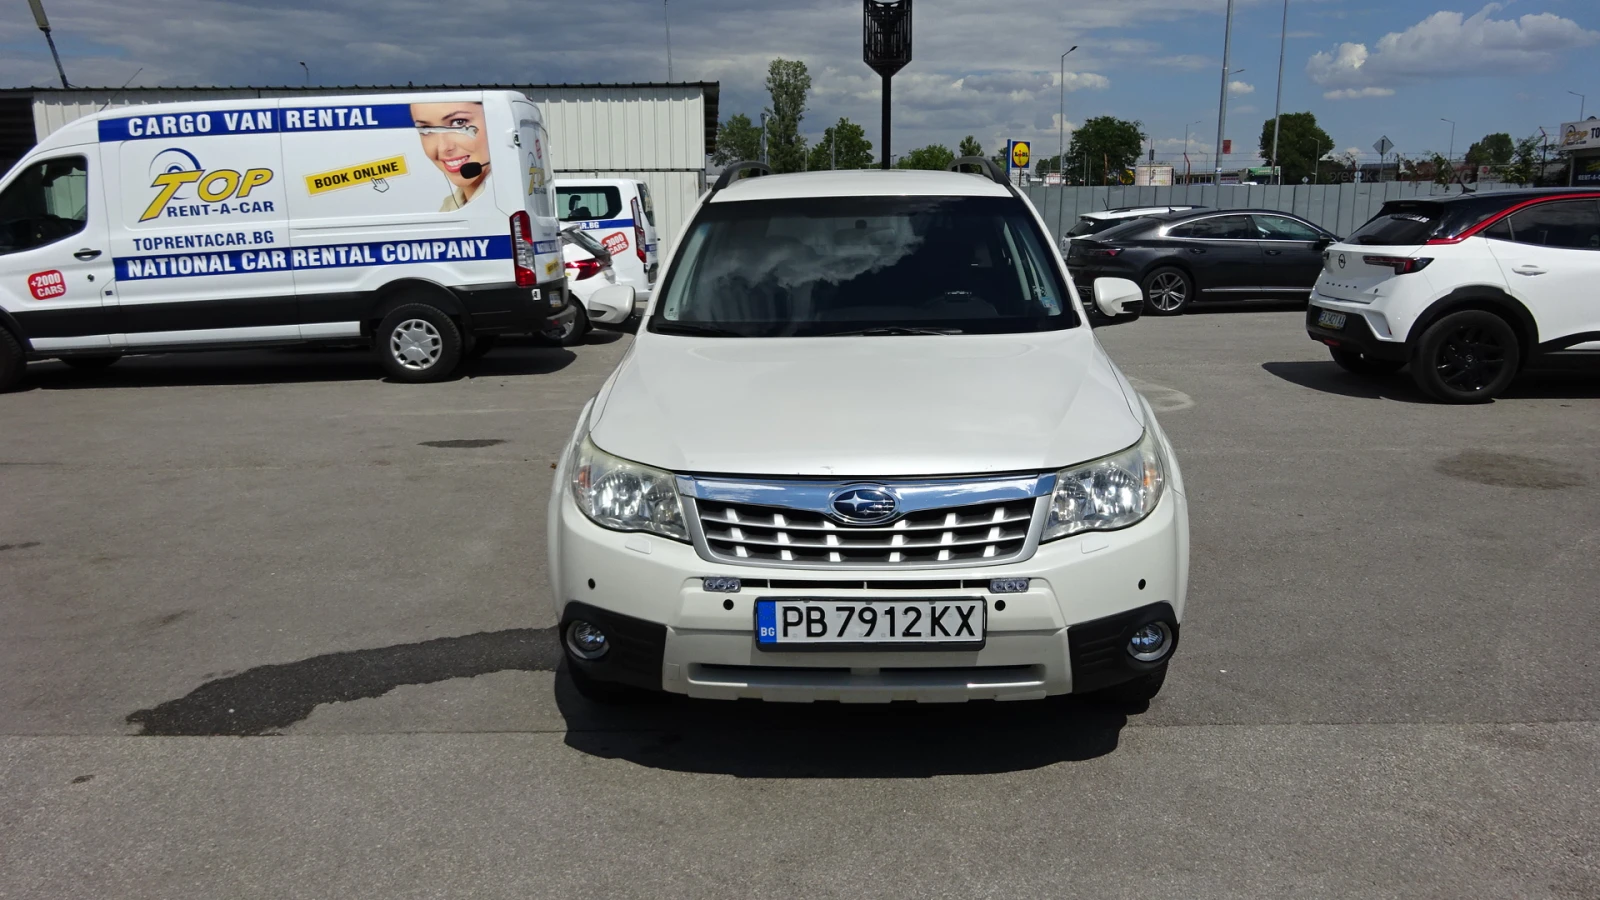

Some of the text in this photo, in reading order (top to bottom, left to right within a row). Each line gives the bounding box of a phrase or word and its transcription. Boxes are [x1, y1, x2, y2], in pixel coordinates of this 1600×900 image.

[128, 107, 379, 137] CARGO VAN RENTAL
[314, 161, 399, 189] BOOK ONLINE
[138, 168, 274, 223] TOP
[166, 201, 275, 217] RENT-A-CAR
[133, 231, 275, 251] TOPRENTACAR.BG
[608, 242, 628, 254] CARS
[127, 239, 490, 278] NATIONAL CAR RENTAL COMPANY
[31, 272, 61, 287] +2000
[37, 284, 64, 297] CARS
[760, 627, 776, 637] BG
